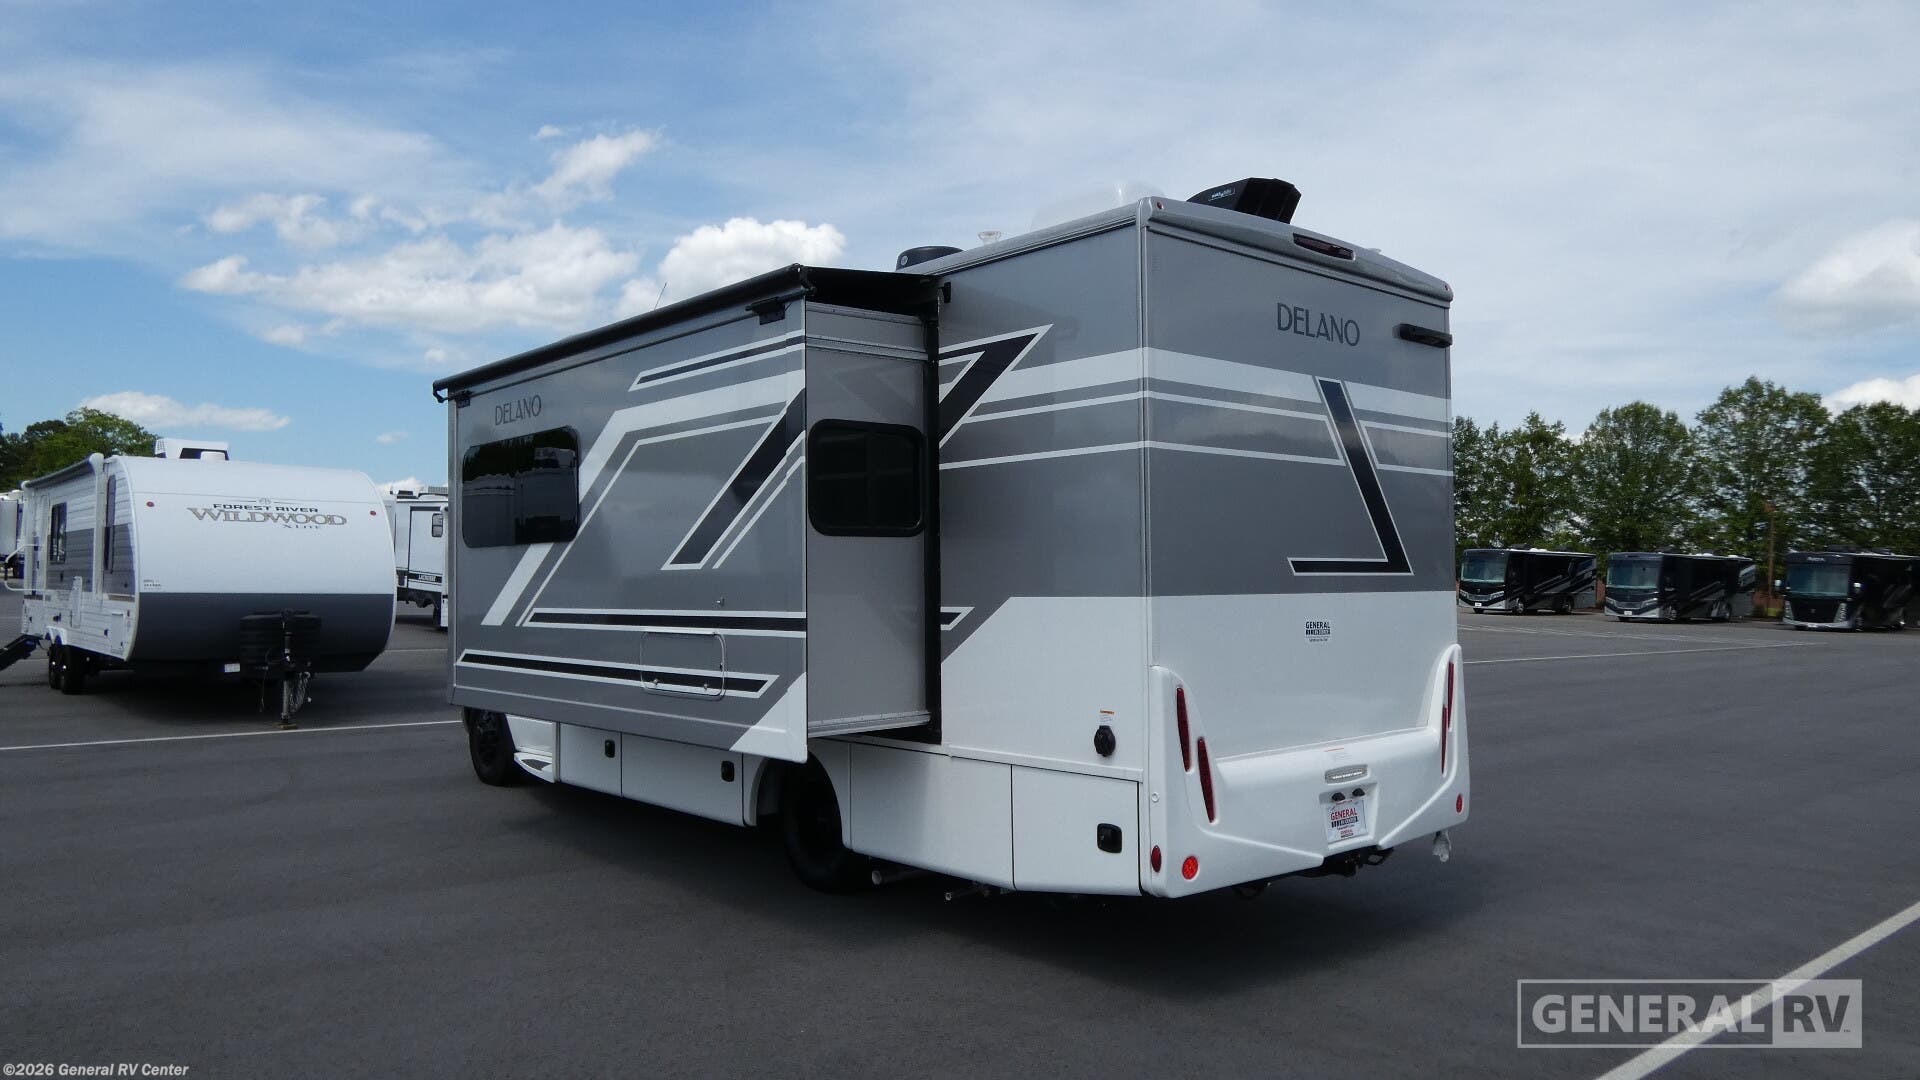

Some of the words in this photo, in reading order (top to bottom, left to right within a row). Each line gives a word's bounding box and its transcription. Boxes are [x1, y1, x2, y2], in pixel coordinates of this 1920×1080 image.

[1277, 302, 1360, 347] DELANO
[495, 394, 542, 426] DELANO
[213, 503, 270, 511] FOREST
[186, 507, 348, 526] WILDWOOD
[1305, 621, 1331, 629] GENERAL
[1330, 807, 1358, 821] GENERAL
